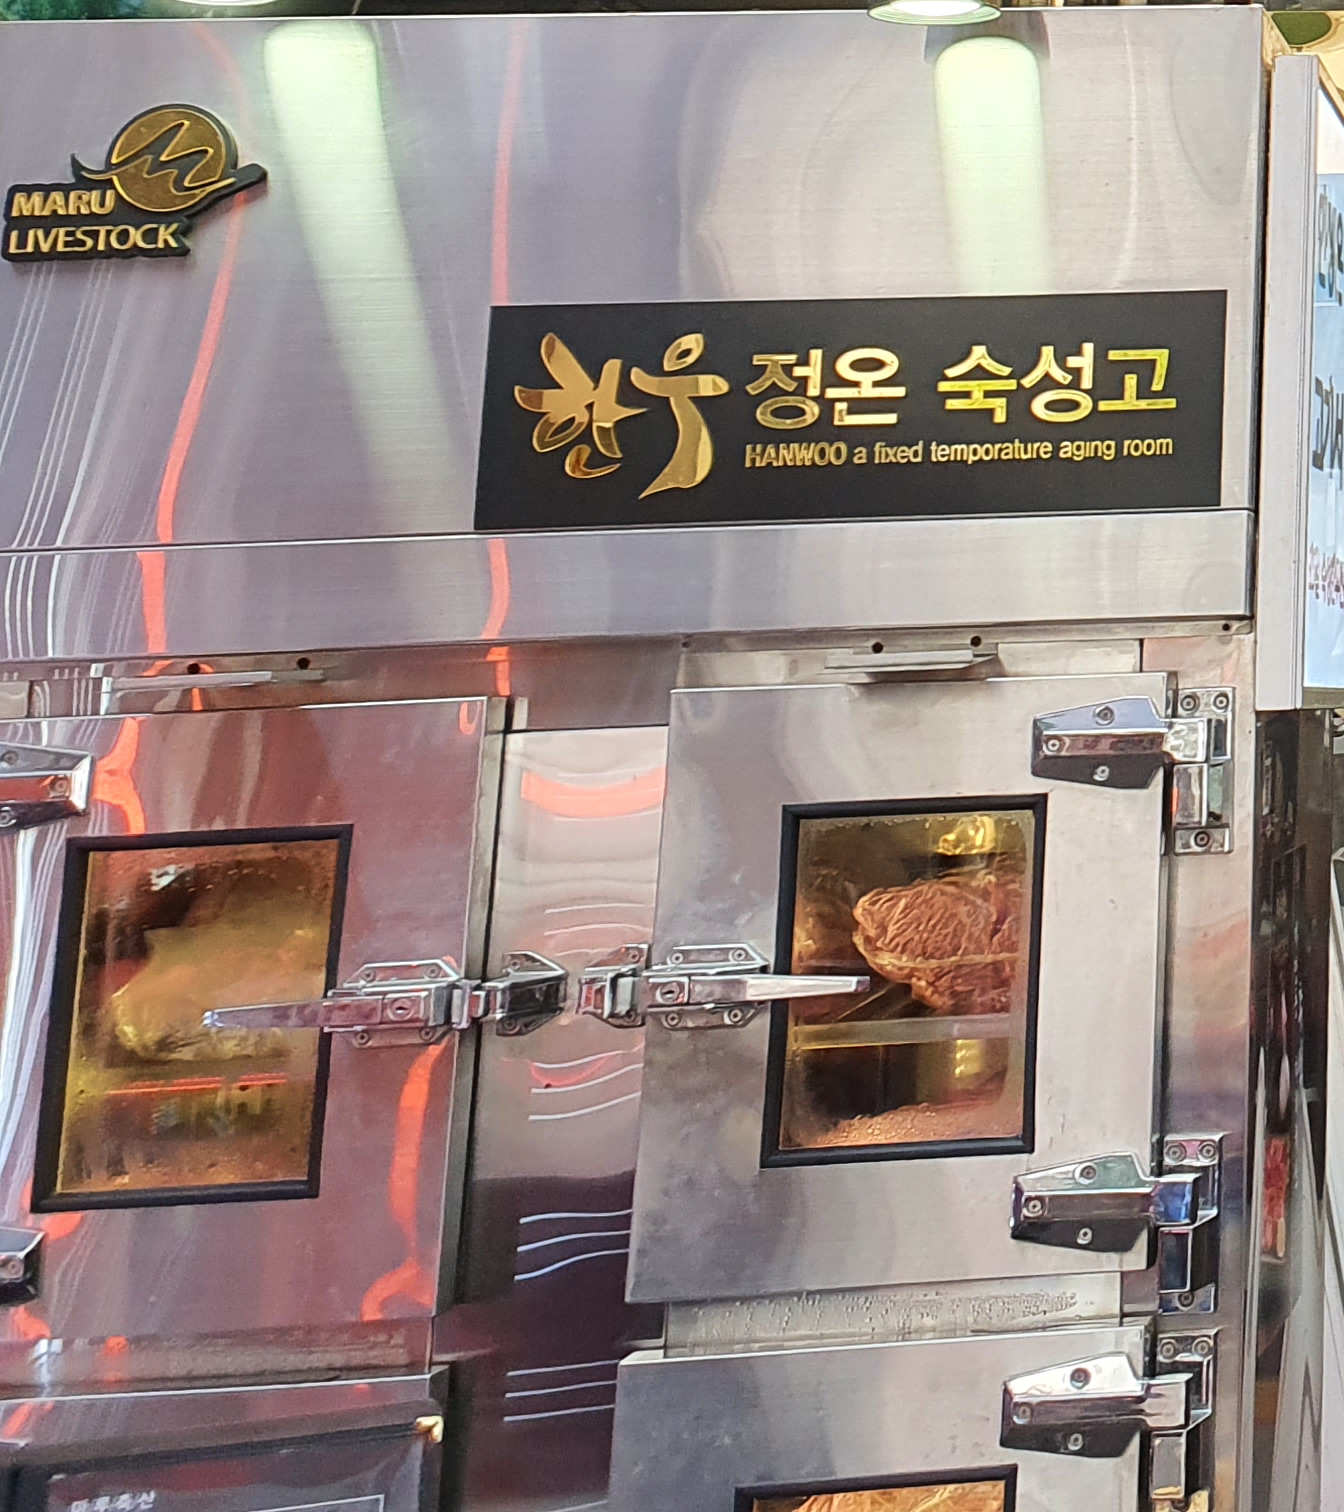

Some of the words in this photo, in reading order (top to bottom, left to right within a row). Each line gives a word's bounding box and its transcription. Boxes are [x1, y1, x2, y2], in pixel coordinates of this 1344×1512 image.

[10, 189, 116, 218] MARU
[7, 222, 181, 255] LIVESTOCK
[744, 346, 907, 430] 정온
[936, 342, 1178, 425] 숙성고
[744, 441, 847, 469] HANWOO
[852, 447, 869, 466] a
[873, 440, 924, 466] fixed
[929, 440, 1053, 470] temporature
[1058, 437, 1116, 464] aging
[1122, 438, 1174, 457] room
